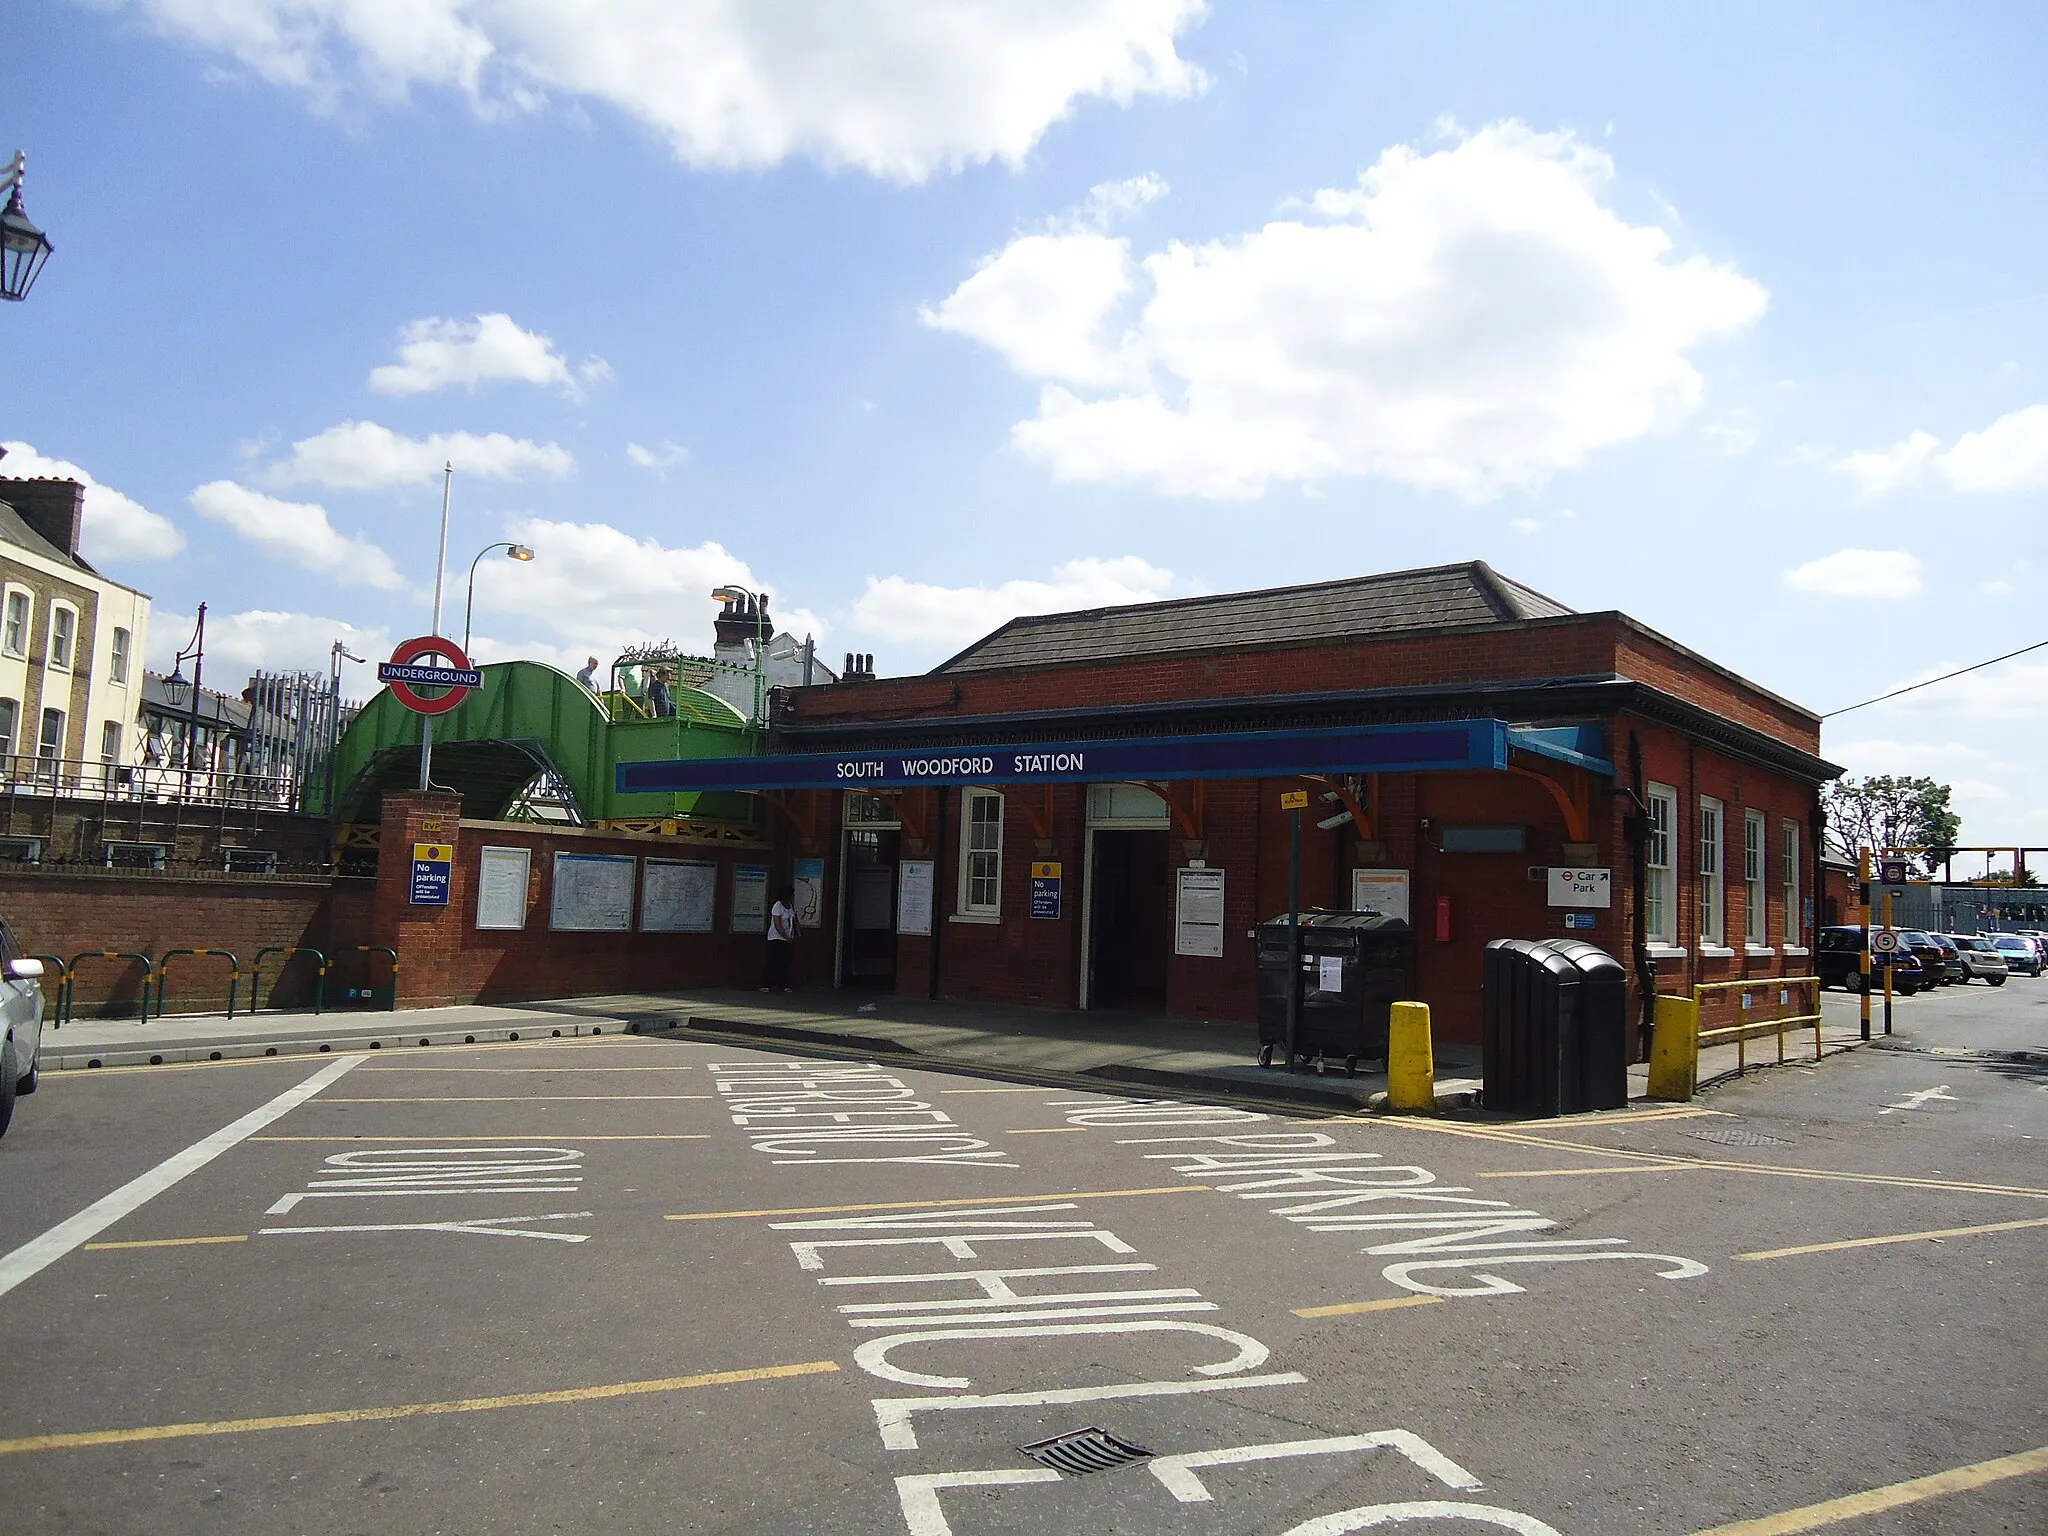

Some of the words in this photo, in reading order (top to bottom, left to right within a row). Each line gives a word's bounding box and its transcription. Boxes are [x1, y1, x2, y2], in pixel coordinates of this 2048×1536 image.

[382, 666, 477, 683] UNDERGROUND
[836, 761, 884, 778] SOUTH
[902, 757, 994, 776] WOODFORD
[1014, 753, 1083, 773] STATION
[424, 822, 440, 830] RVP
[416, 874, 446, 883] parking
[1577, 872, 1595, 881] Car
[1034, 890, 1057, 899] parking
[1573, 883, 1595, 893] Park
[1882, 937, 1890, 946] 5
[707, 1061, 1020, 1168] EMERGENCY
[1043, 1100, 1270, 1126] NO
[258, 1147, 593, 1243] ONLY
[1114, 1132, 1709, 1297] PARKING
[768, 1203, 1563, 1536] VEHICLE
